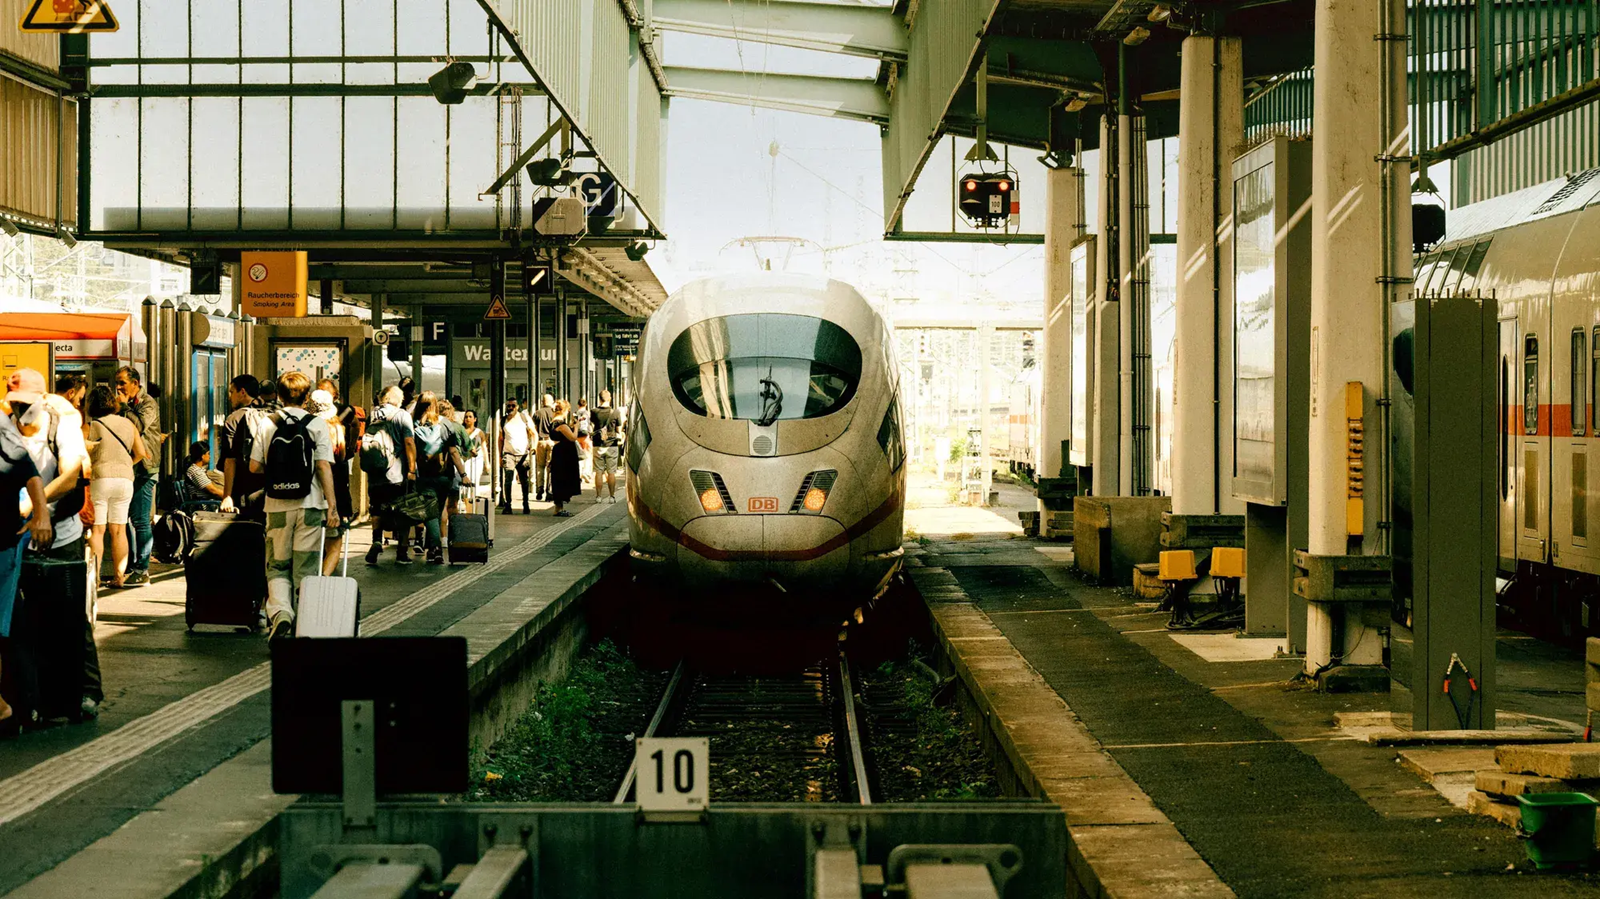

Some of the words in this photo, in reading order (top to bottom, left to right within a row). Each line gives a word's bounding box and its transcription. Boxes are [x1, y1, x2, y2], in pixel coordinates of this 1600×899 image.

[576, 174, 601, 206] G
[433, 322, 444, 340] F
[55, 344, 73, 352] ecta
[273, 482, 300, 490] adidas
[752, 499, 775, 510] DB
[651, 750, 694, 793] 10
